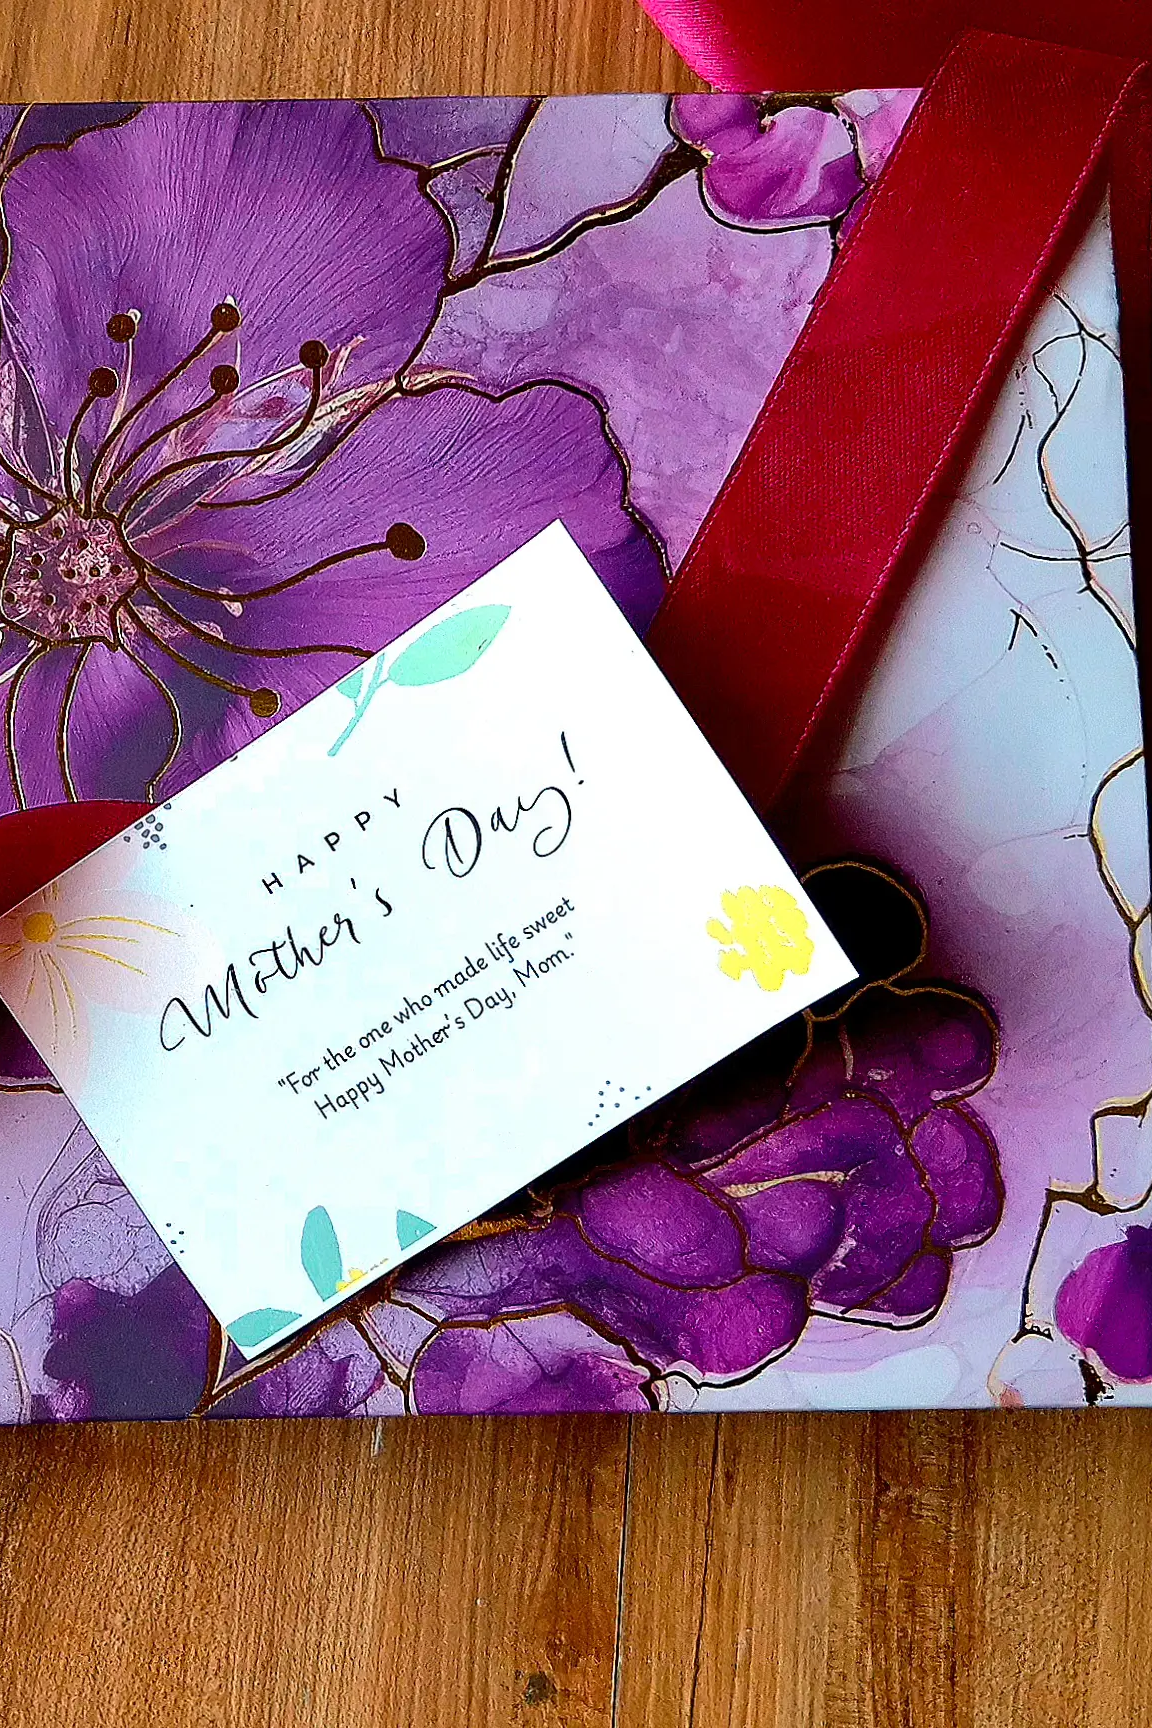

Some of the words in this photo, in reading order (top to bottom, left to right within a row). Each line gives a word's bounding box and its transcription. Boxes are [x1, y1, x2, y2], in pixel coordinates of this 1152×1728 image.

[159, 877, 393, 1052] Mother's
[422, 731, 585, 878] Day!
[261, 788, 401, 894] HAPPY
[277, 1065, 321, 1095] "For
[322, 1047, 357, 1071] the
[358, 1020, 393, 1049] one
[392, 996, 433, 1024] who
[433, 955, 489, 998] made
[484, 932, 521, 964] life
[522, 896, 575, 940] sweet
[313, 1072, 386, 1120] Happy
[377, 1013, 466, 1077] Mother's
[463, 987, 517, 1020] Day,
[512, 931, 575, 988] Mom."
